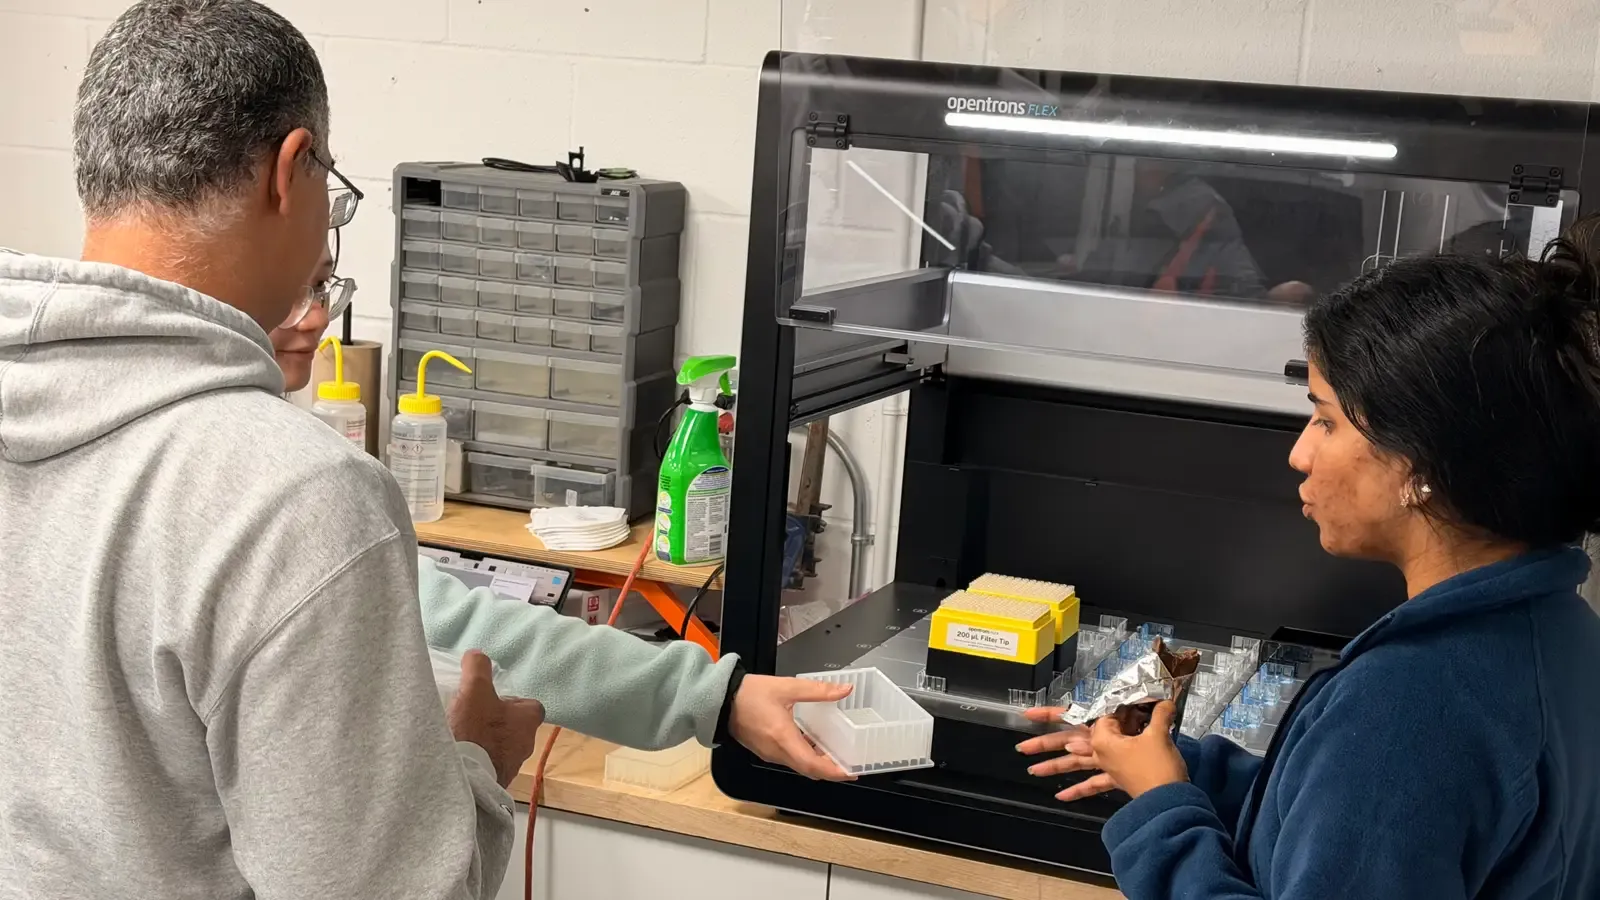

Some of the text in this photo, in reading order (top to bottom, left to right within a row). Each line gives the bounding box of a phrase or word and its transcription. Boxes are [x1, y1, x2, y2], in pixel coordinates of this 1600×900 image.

[947, 96, 1058, 117] opentrons FLEX
[957, 630, 970, 639] 200
[980, 635, 998, 644] Filter
[999, 638, 1010, 646] Tip
